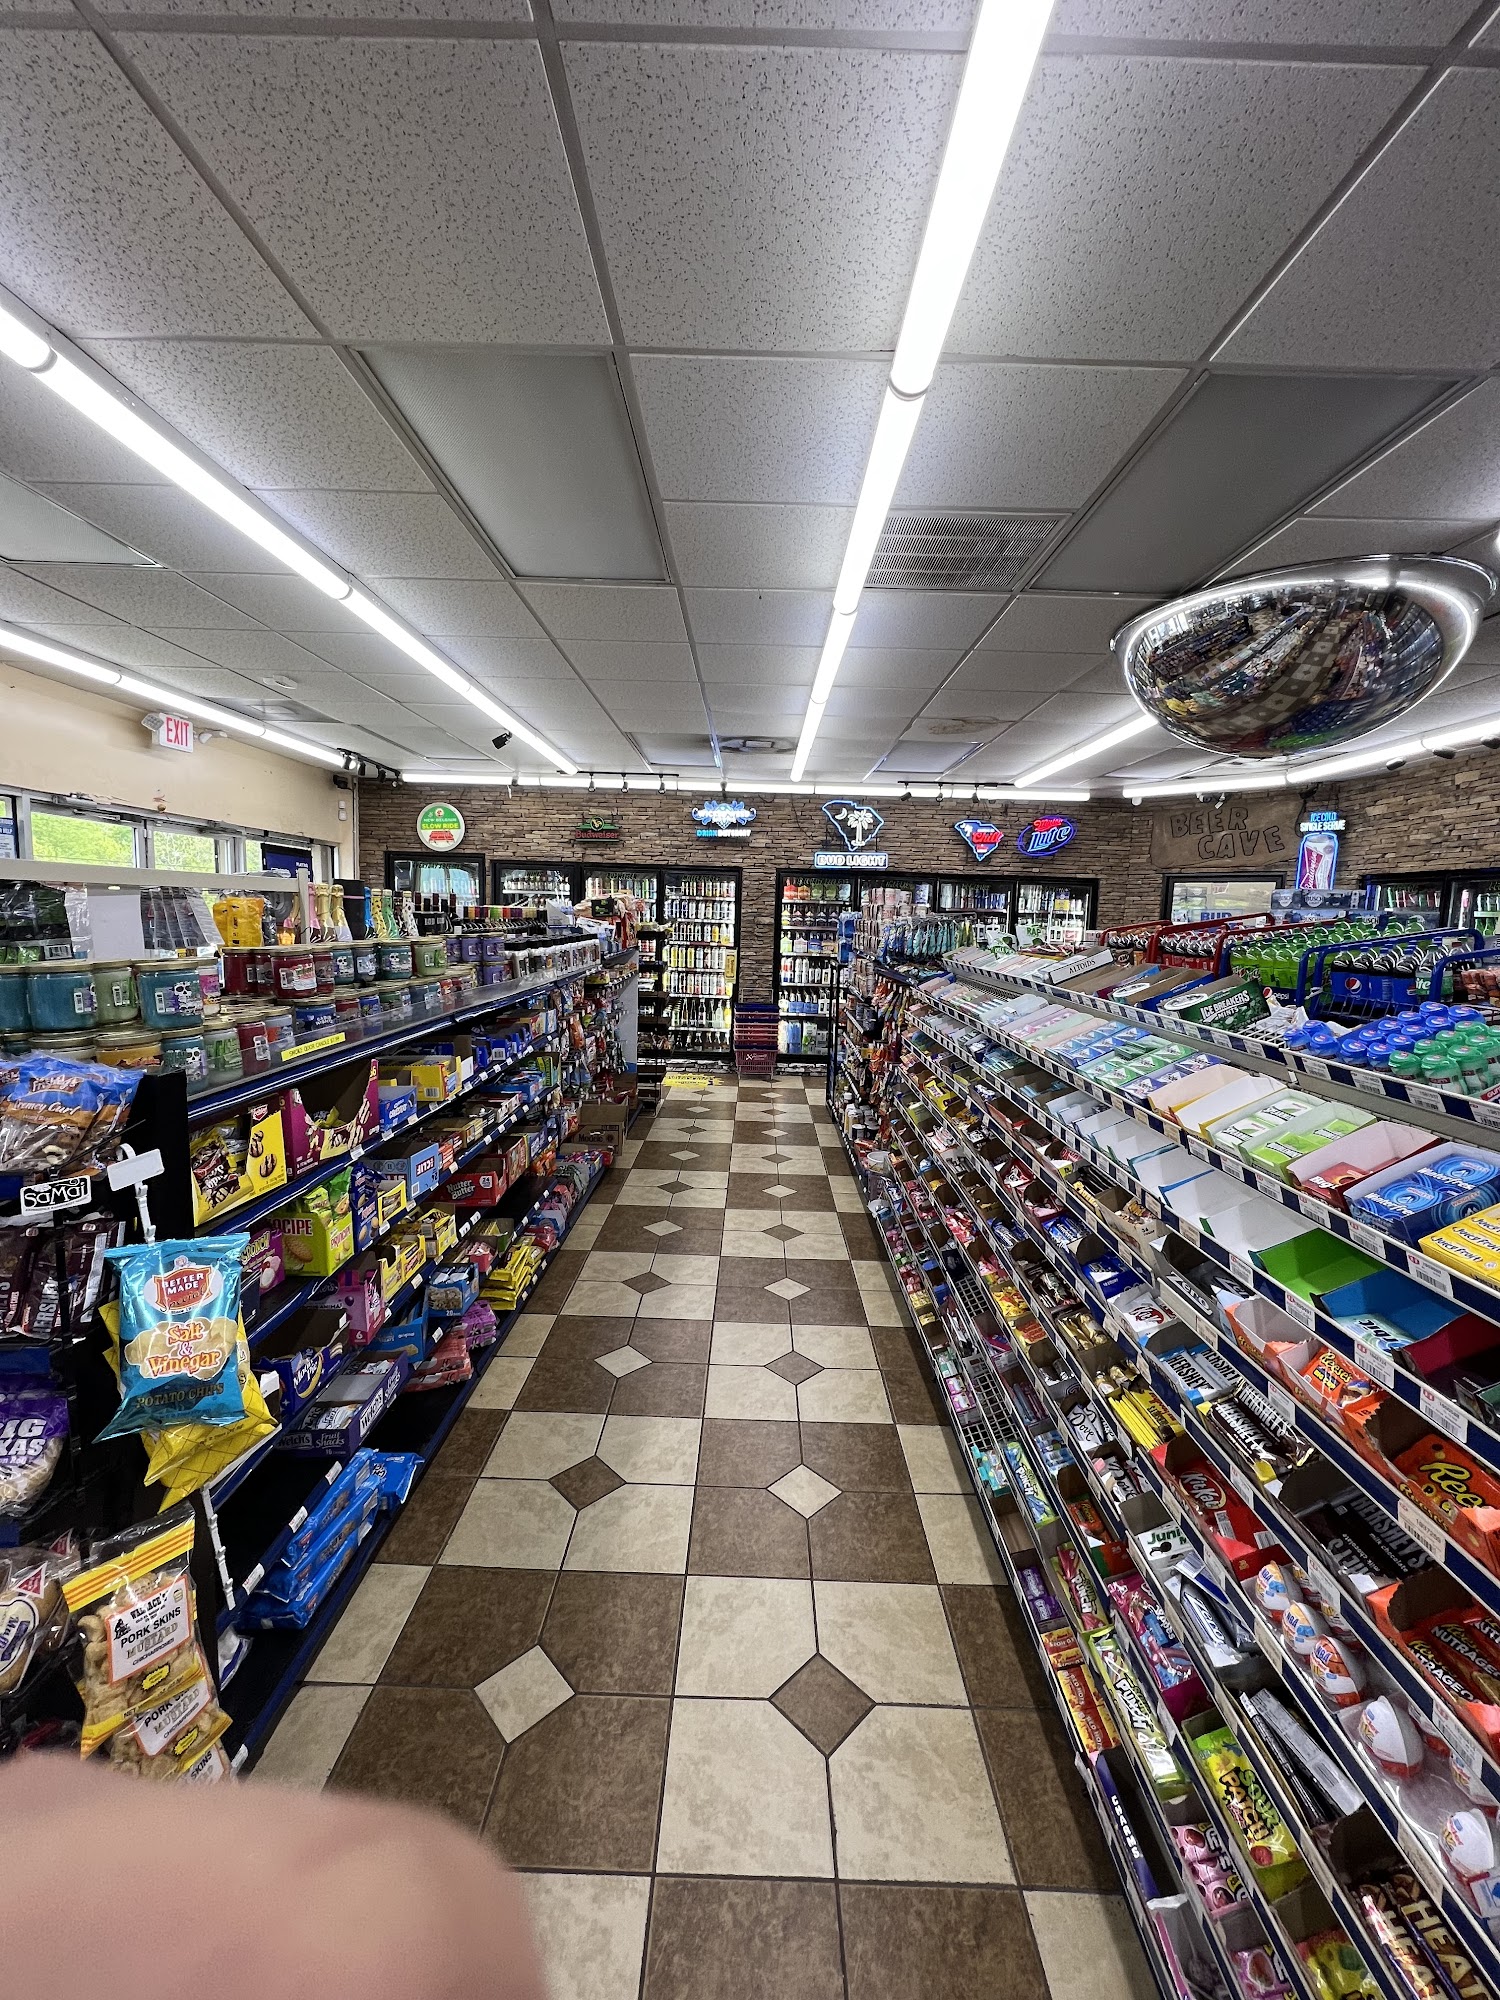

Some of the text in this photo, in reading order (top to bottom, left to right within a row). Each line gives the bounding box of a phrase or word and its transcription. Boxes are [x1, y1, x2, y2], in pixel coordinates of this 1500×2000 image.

[166, 716, 190, 747] EXIT
[576, 830, 620, 839] Budweiser
[1170, 806, 1249, 838] BEER
[1198, 826, 1286, 860] CAVE
[817, 855, 886, 866] BUD LIGHT
[1069, 959, 1096, 974] ALTOIDS
[1200, 990, 1250, 1019] ICE BREAKERS
[1217, 1007, 1239, 1019] MINTS
[446, 1180, 472, 1193] Nutter
[452, 1186, 476, 1200] Butter
[163, 1273, 204, 1288] BETTER
[167, 1281, 199, 1295] MADE
[1166, 1271, 1213, 1316] Zero
[168, 1322, 204, 1345] Salt
[179, 1342, 192, 1356] &
[147, 1350, 221, 1377] Vinegar
[1320, 1351, 1353, 1383] Reese's
[136, 1382, 225, 1409] POTATO CHIPS
[0, 1418, 47, 1438] IG
[321, 1432, 340, 1441] Fruit
[1070, 1411, 1094, 1442] Dove
[315, 1438, 345, 1449] Snacks
[1015, 1466, 1034, 1495] PUNCH
[1148, 1527, 1181, 1545] Juni
[1261, 1567, 1274, 1582] NBA
[1071, 1575, 1093, 1613] PUNCH
[121, 1624, 150, 1649] PORK
[153, 1607, 181, 1630] SKINS
[1184, 1591, 1225, 1643] Zero
[1286, 1612, 1299, 1628] NBA
[126, 1622, 179, 1660] MUSTARD
[1315, 1646, 1333, 1662] NBA
[144, 1700, 173, 1727] PORK
[1114, 1679, 1148, 1729] PUNCH
[190, 1750, 213, 1780] SKINS
